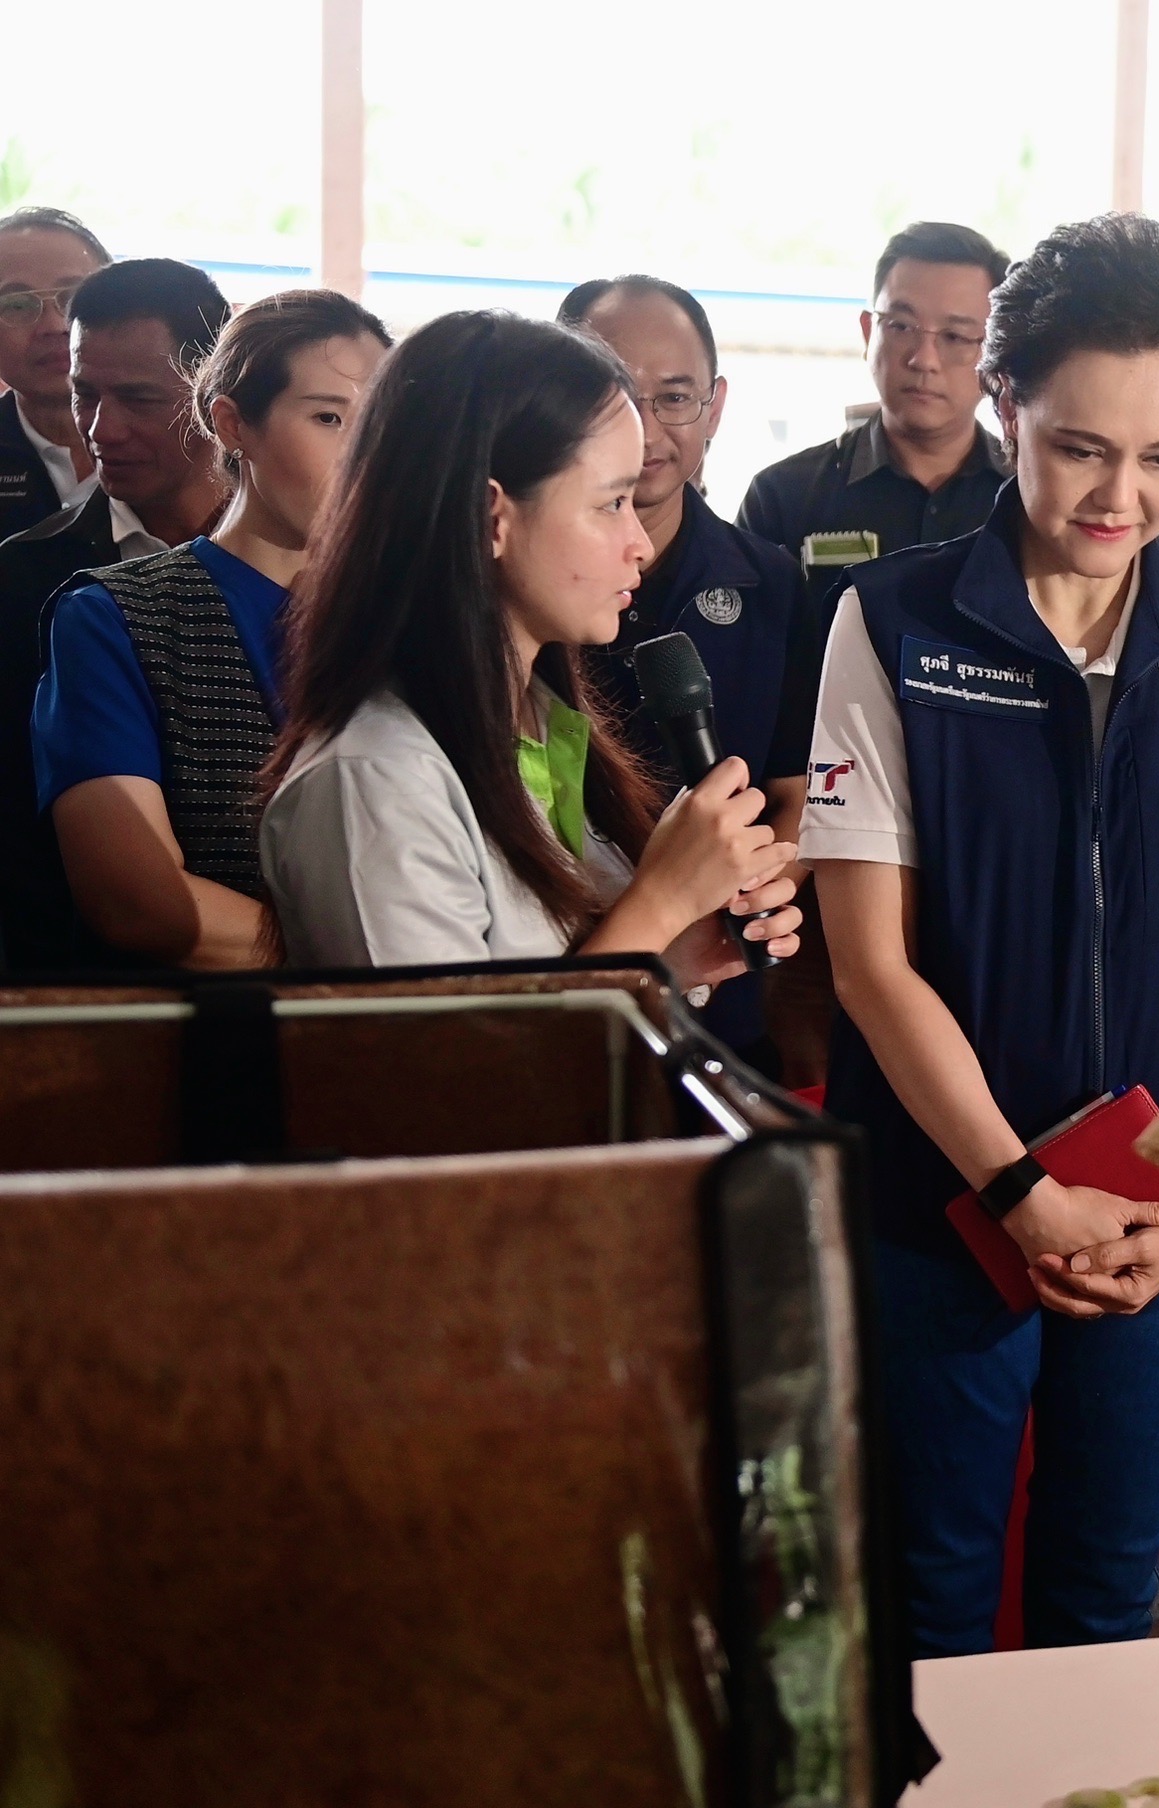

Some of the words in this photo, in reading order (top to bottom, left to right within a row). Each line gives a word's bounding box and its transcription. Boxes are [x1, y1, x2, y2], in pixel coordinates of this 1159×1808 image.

[920, 654, 949, 673] ศุภจี
[956, 662, 1036, 689] สุธรรมพันธุ์
